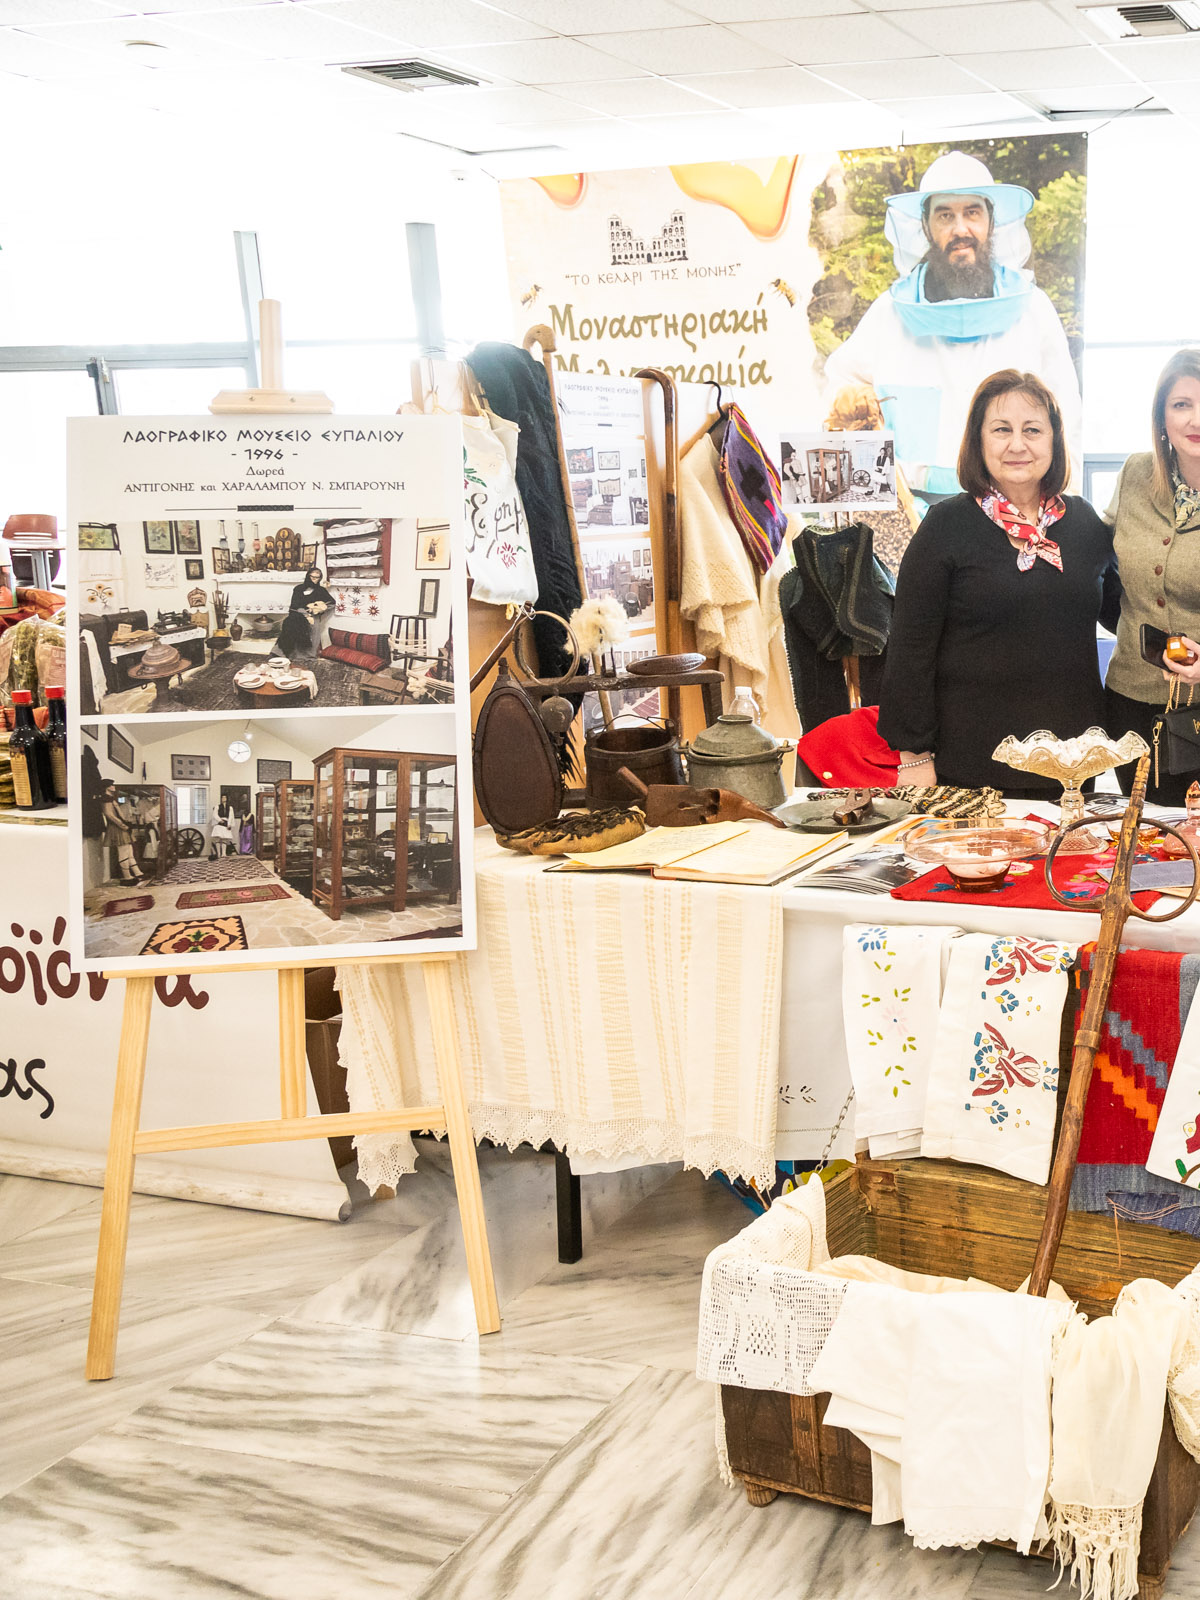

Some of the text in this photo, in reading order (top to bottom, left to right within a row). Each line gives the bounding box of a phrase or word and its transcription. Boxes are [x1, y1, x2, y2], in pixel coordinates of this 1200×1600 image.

[598, 271, 643, 286] ΚΕΛΑΡΙ
[650, 268, 679, 281] ΤΗΣ
[548, 292, 768, 353] Μοναστηριακή
[123, 429, 404, 443] ΛΑΟΓΡΑΦΙΚΟ ΜΟΥΣΕΙΟ ΕΥΠΑΛΙΟΥ
[244, 448, 284, 460] 1996
[246, 466, 285, 478] Δωρεά
[124, 481, 405, 493] ΑΝΤΙΓΟΝΗΣ και ΧΑΡΑΛΑΜΠΟΥ Ν. ΣΜΠΑΡΟΥΝΗ
